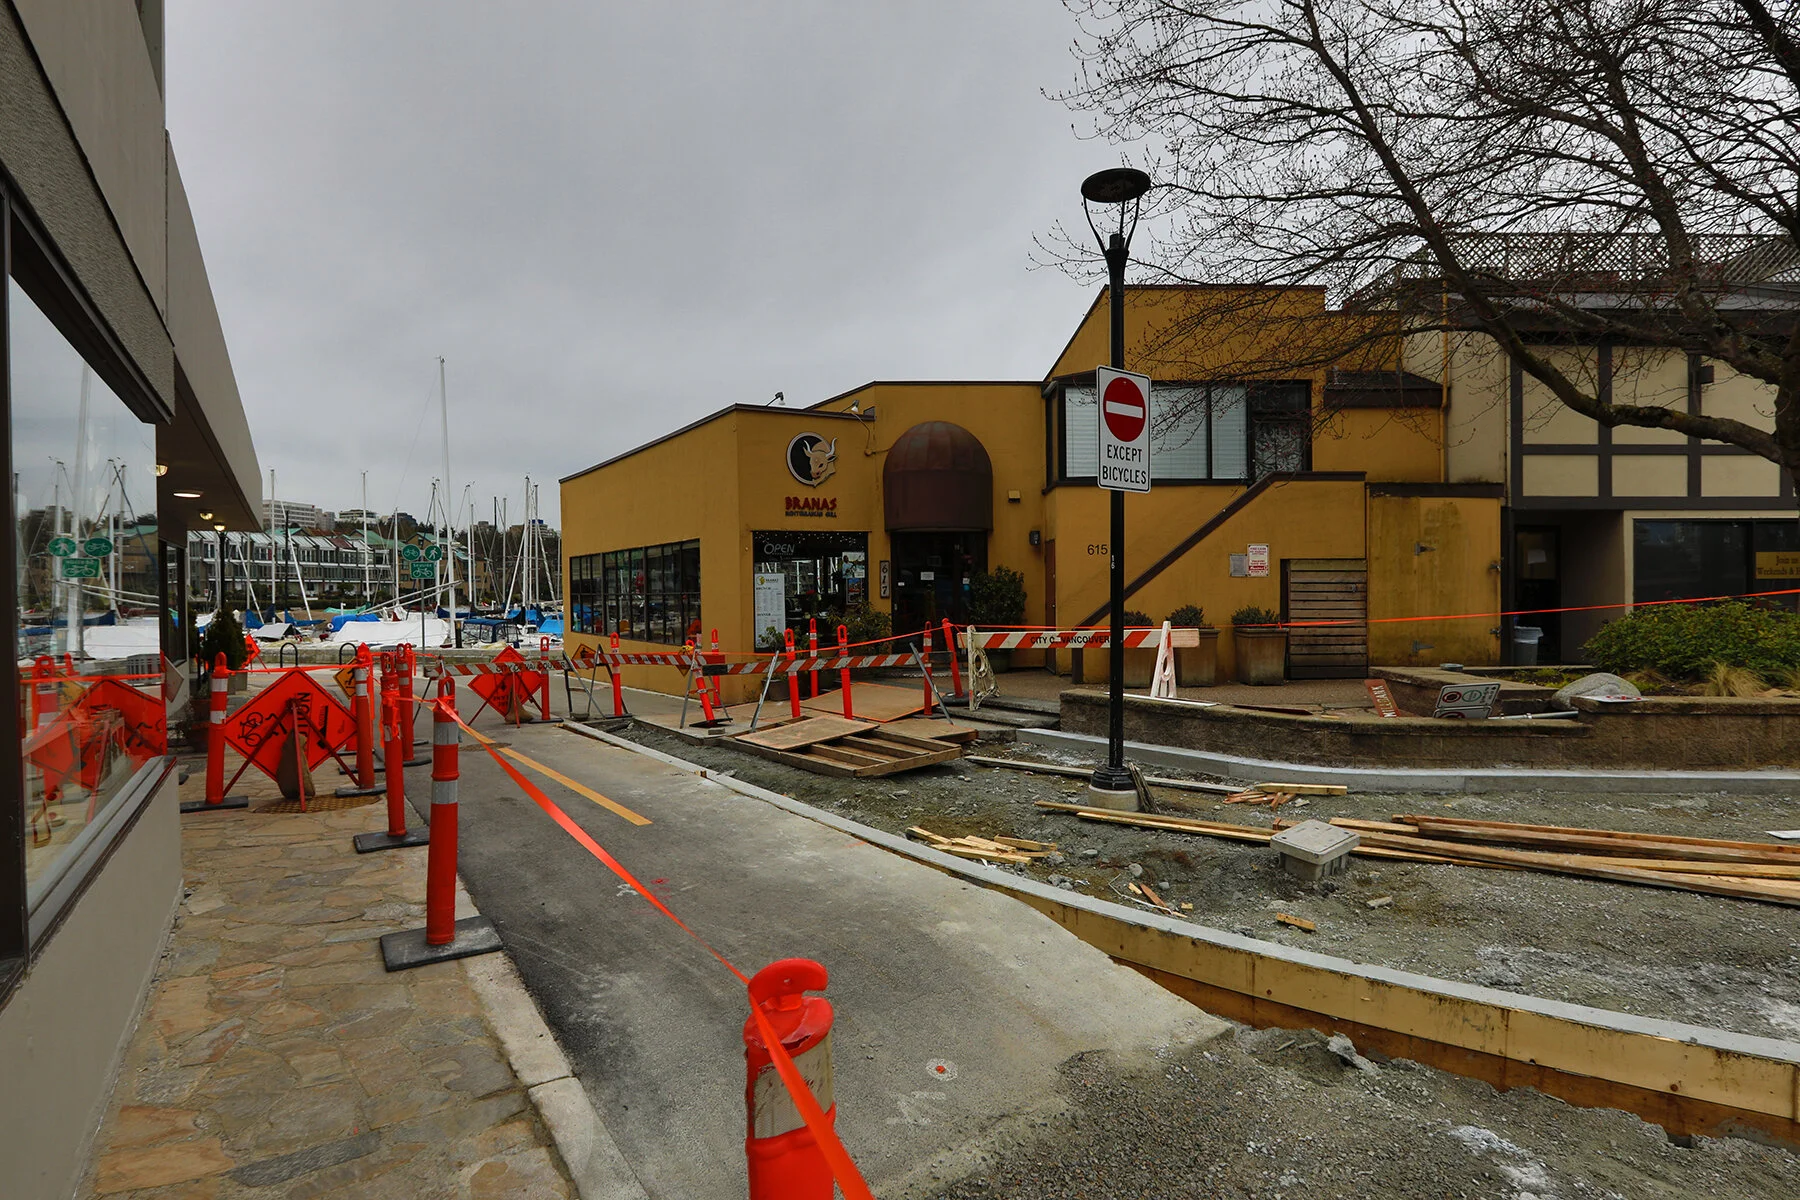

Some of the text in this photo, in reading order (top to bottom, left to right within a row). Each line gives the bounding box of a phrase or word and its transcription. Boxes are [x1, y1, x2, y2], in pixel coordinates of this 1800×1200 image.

[1107, 444, 1142, 462] EXCEPT
[1102, 465, 1146, 485] BICYCLES
[785, 496, 838, 511] BRANAS
[763, 543, 796, 555] OPEN
[1087, 544, 1109, 556] 615
[881, 563, 889, 595] 617
[1030, 636, 1048, 645] CITY
[1060, 635, 1111, 645] VANCOUVER
